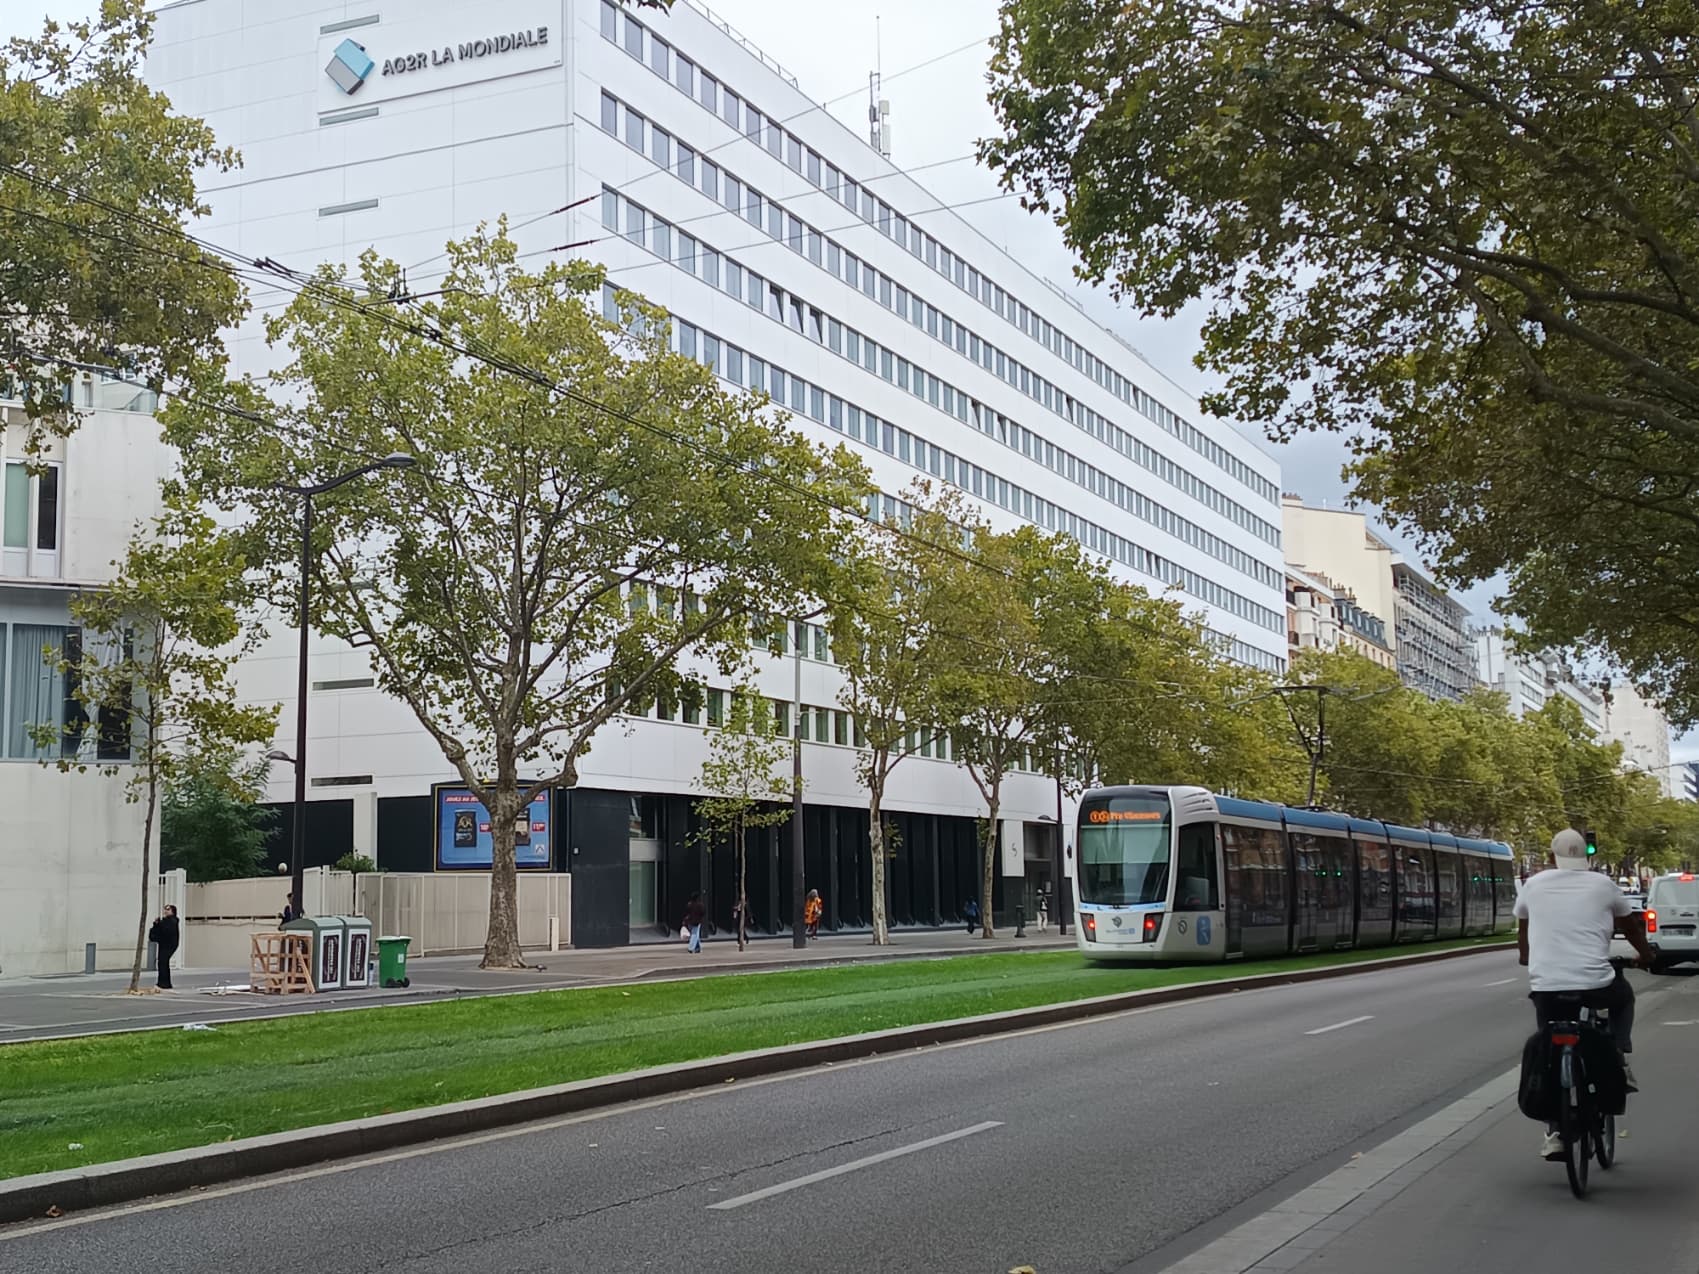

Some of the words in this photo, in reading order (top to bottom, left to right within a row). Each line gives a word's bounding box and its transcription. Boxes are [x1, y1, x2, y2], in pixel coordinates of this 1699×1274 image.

[382, 53, 428, 76] AG2R
[432, 47, 454, 66] LA
[458, 26, 548, 61] MONDIALE
